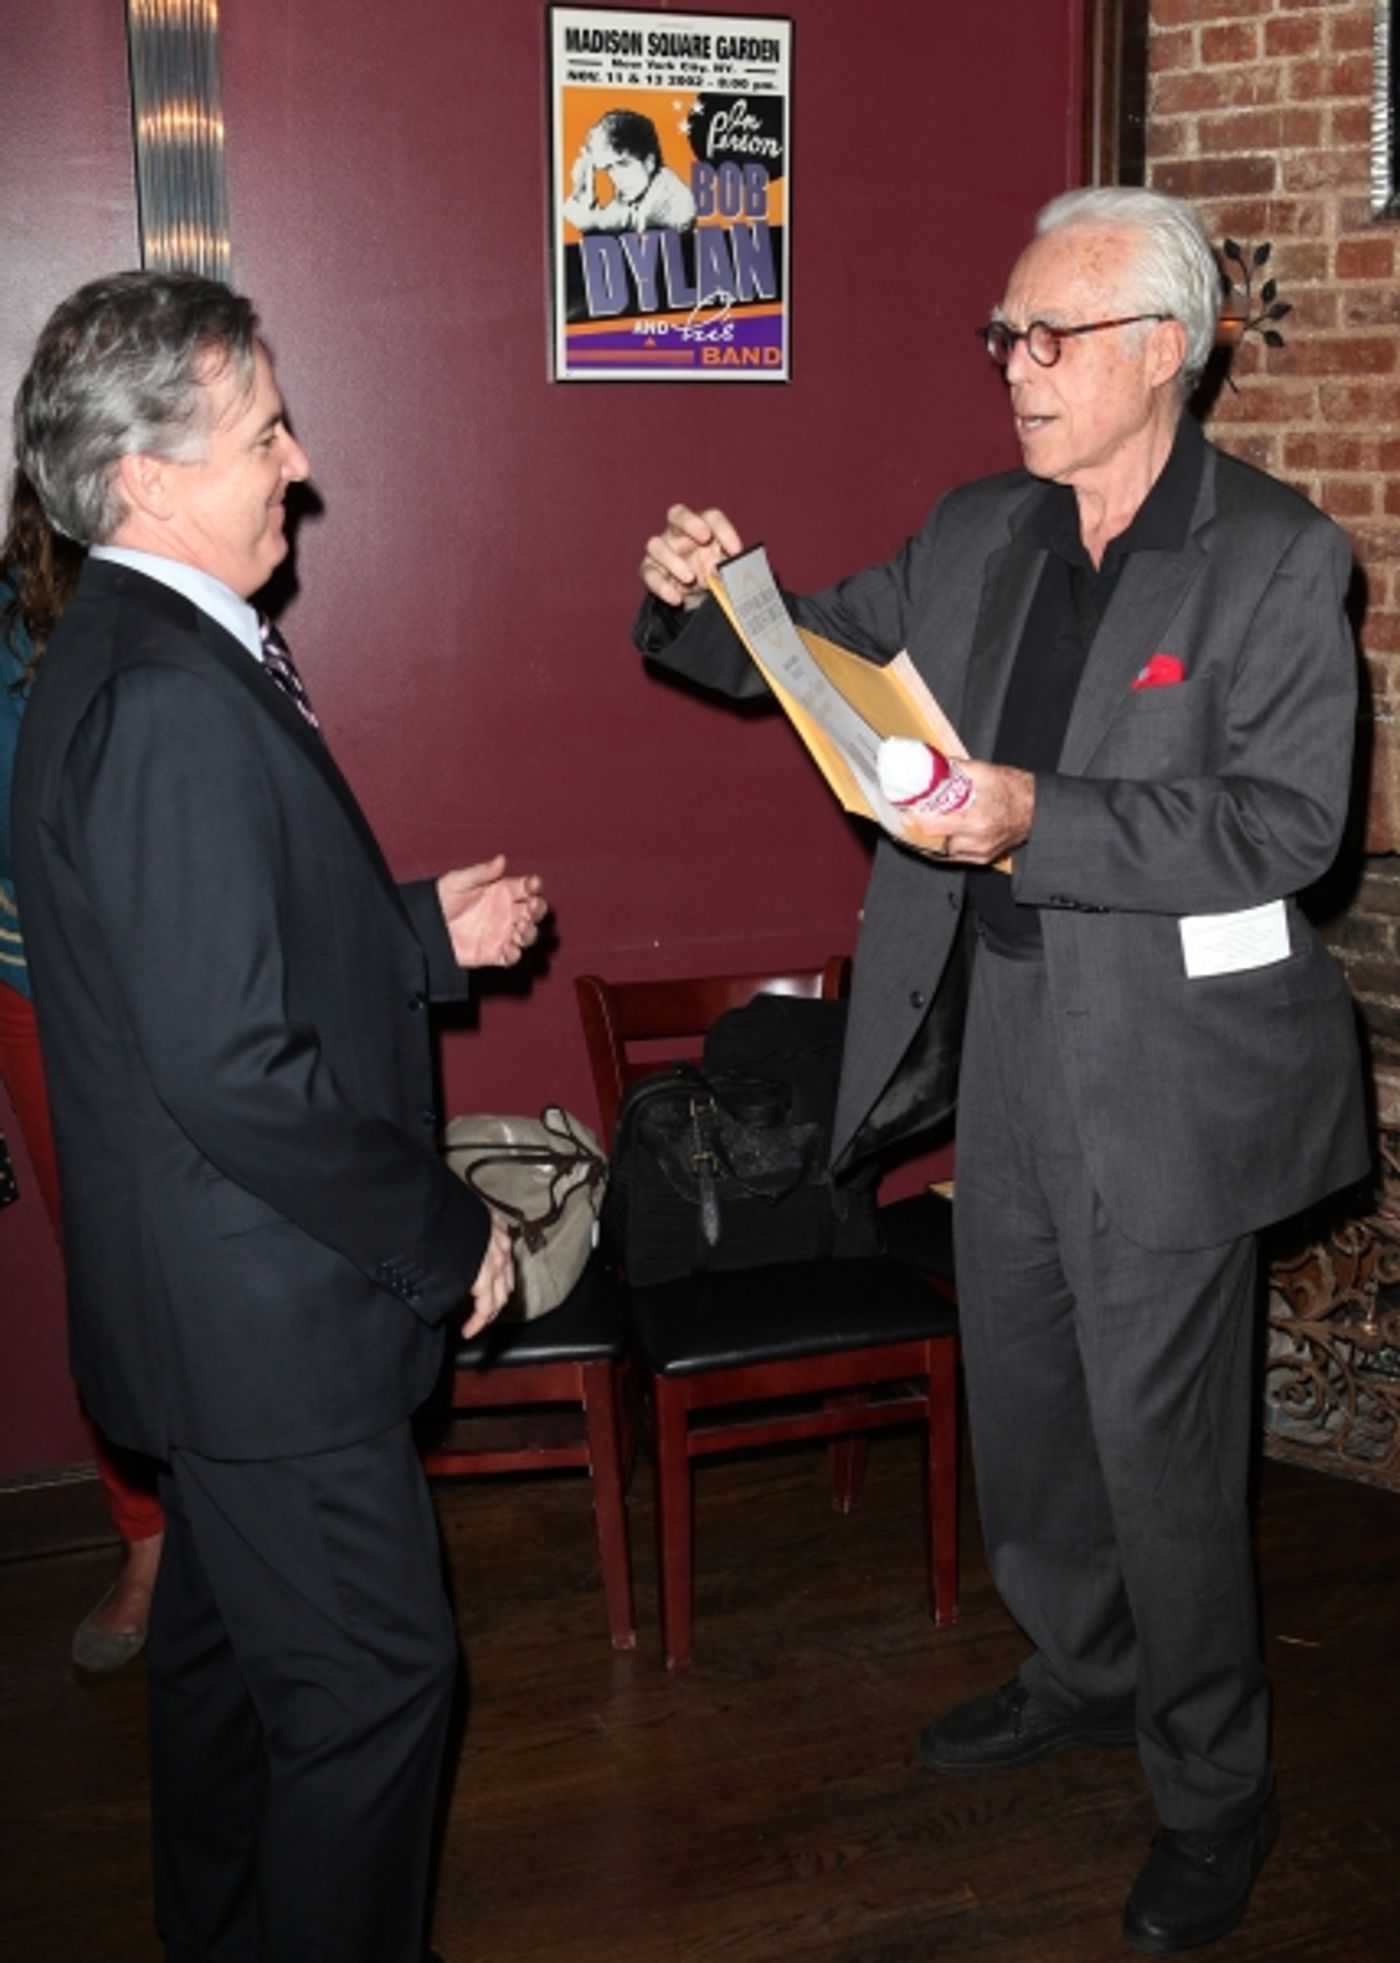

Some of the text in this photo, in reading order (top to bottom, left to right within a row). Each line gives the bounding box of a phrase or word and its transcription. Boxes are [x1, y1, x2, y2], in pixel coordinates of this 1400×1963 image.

[565, 27, 780, 63] MADISON SQUARE GARDEN
[611, 58, 642, 69] New
[647, 60, 675, 71] York
[692, 162, 770, 218] BOB
[579, 223, 777, 318] DYLAN
[632, 320, 670, 335] AND
[702, 346, 781, 365] BAND
